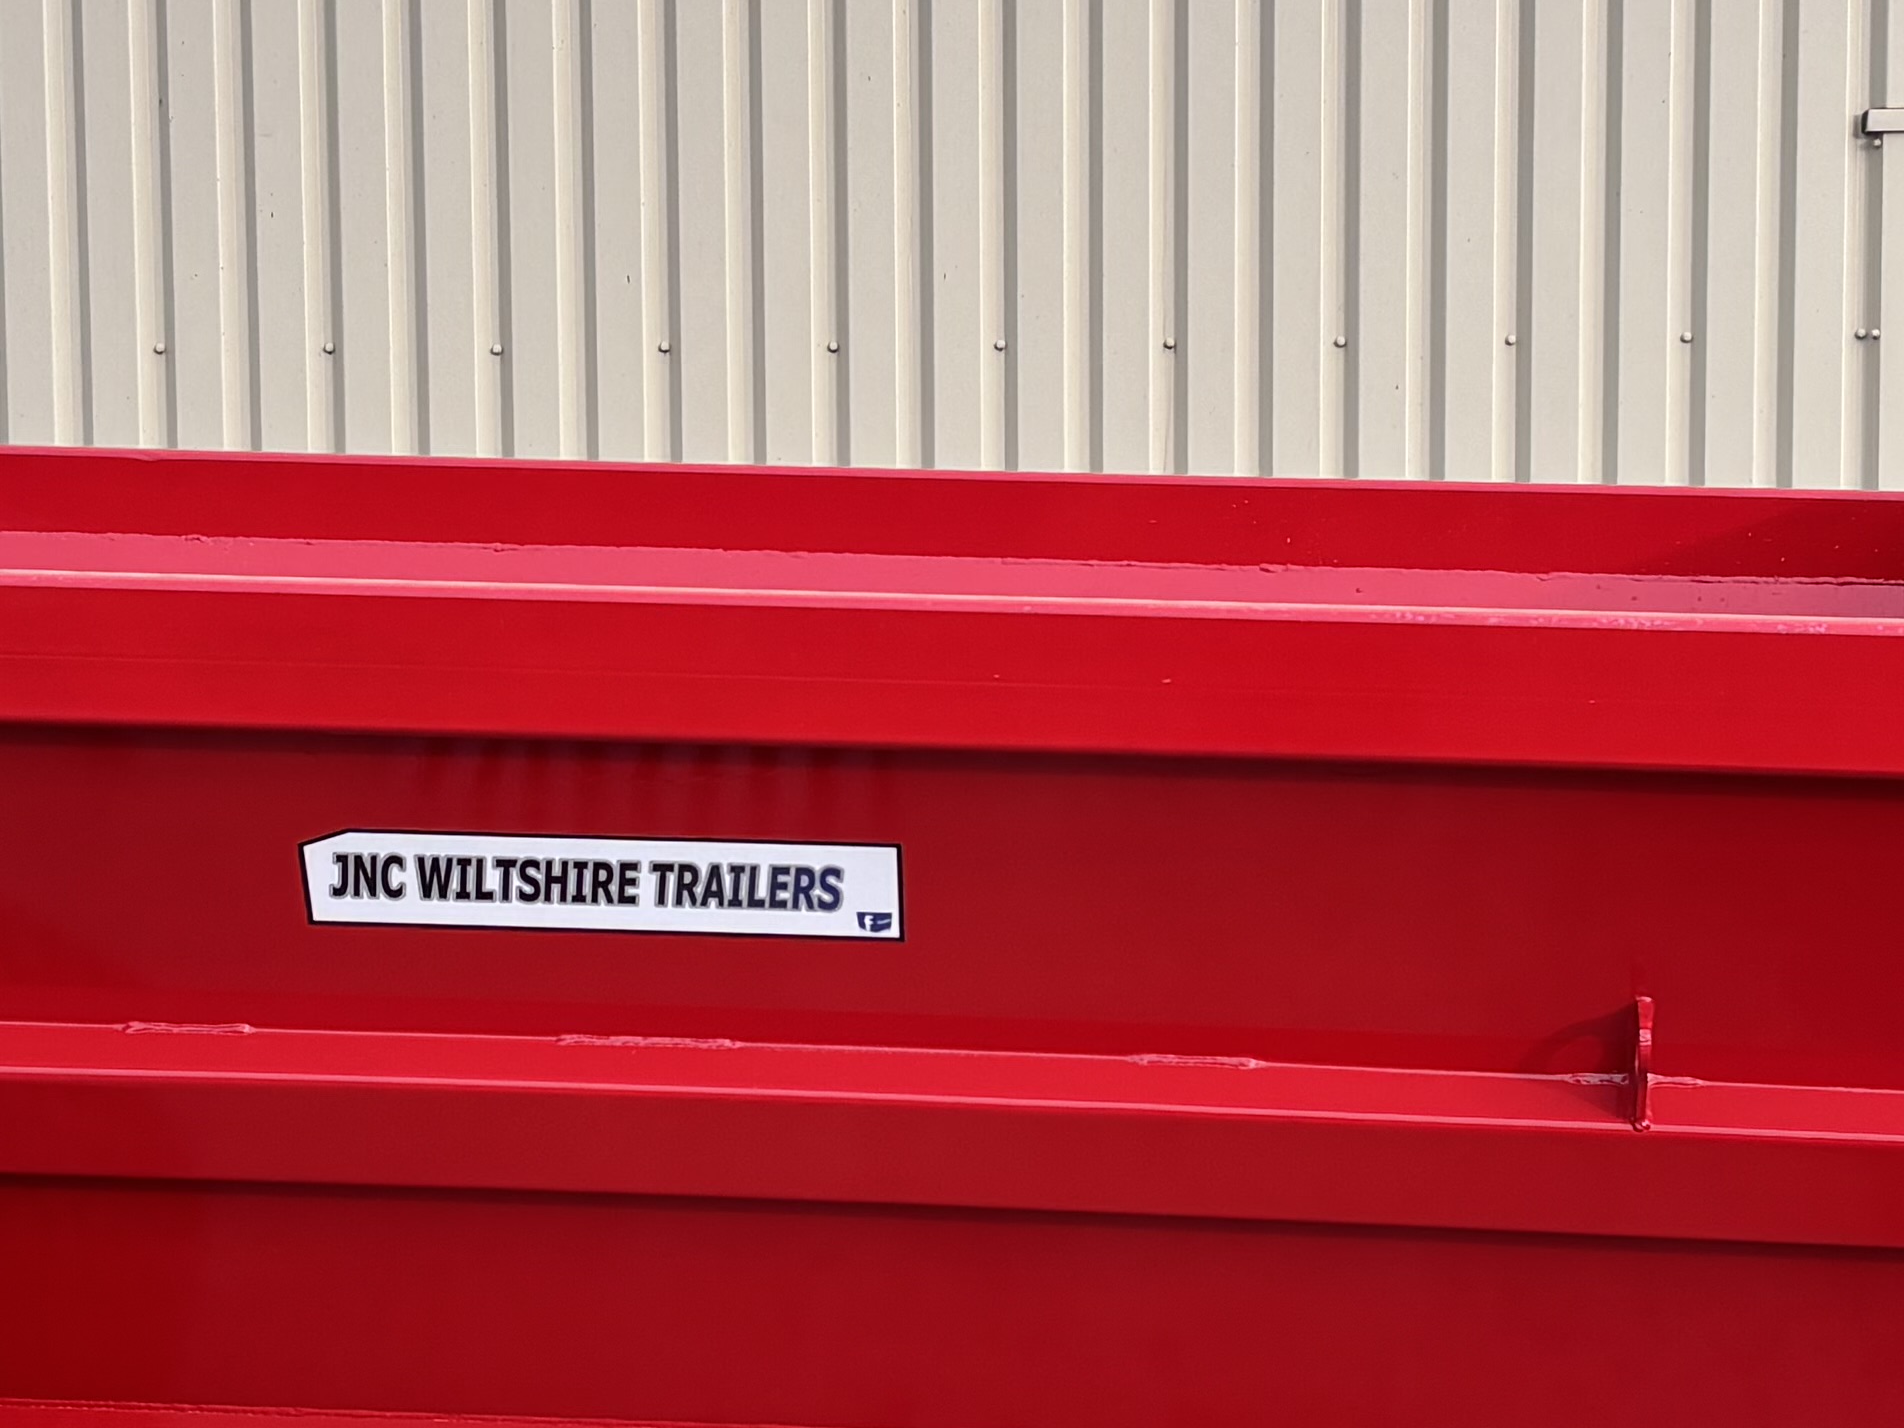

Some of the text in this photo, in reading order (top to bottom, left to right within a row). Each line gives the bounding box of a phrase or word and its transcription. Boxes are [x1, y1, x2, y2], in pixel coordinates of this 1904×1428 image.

[329, 852, 845, 914] JNC WILTSHIRE TRAILERS
